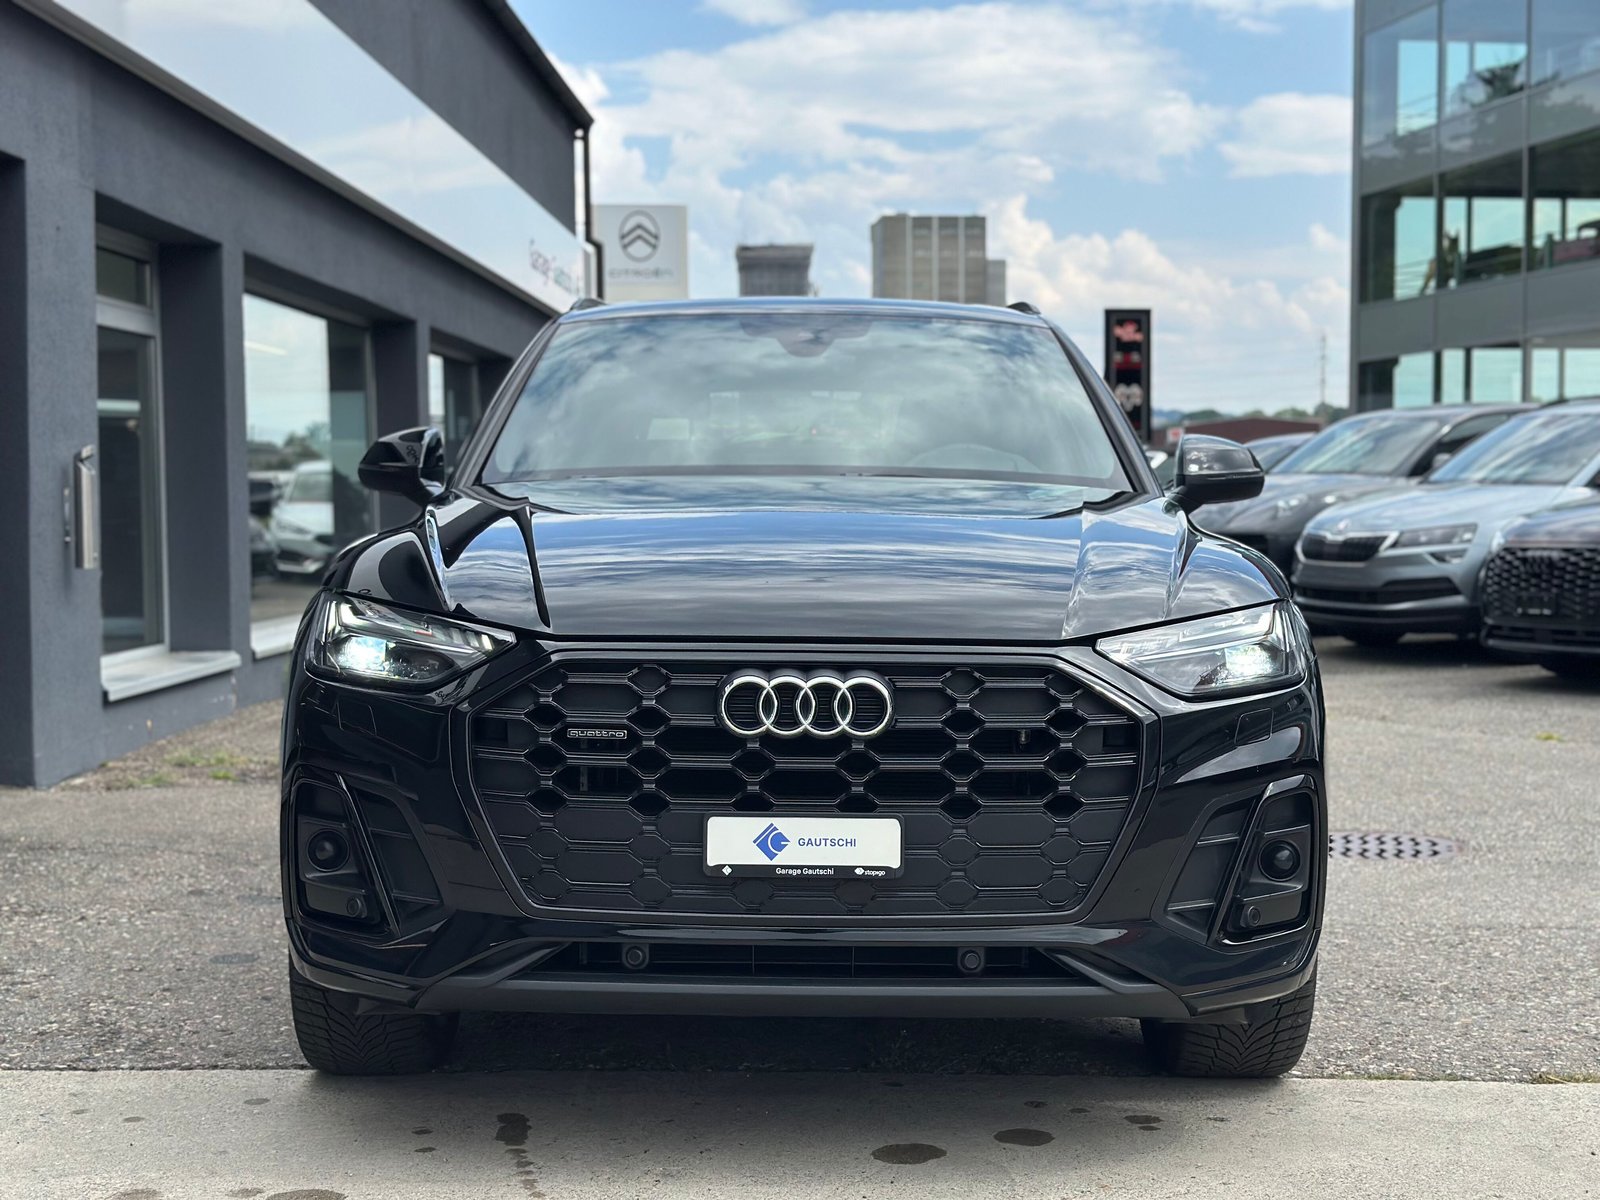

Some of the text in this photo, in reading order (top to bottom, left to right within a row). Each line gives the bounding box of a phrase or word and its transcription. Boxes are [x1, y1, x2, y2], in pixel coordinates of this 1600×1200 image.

[797, 837, 857, 847] GAUTSCHI
[775, 867, 834, 876] Garage Gautschi
